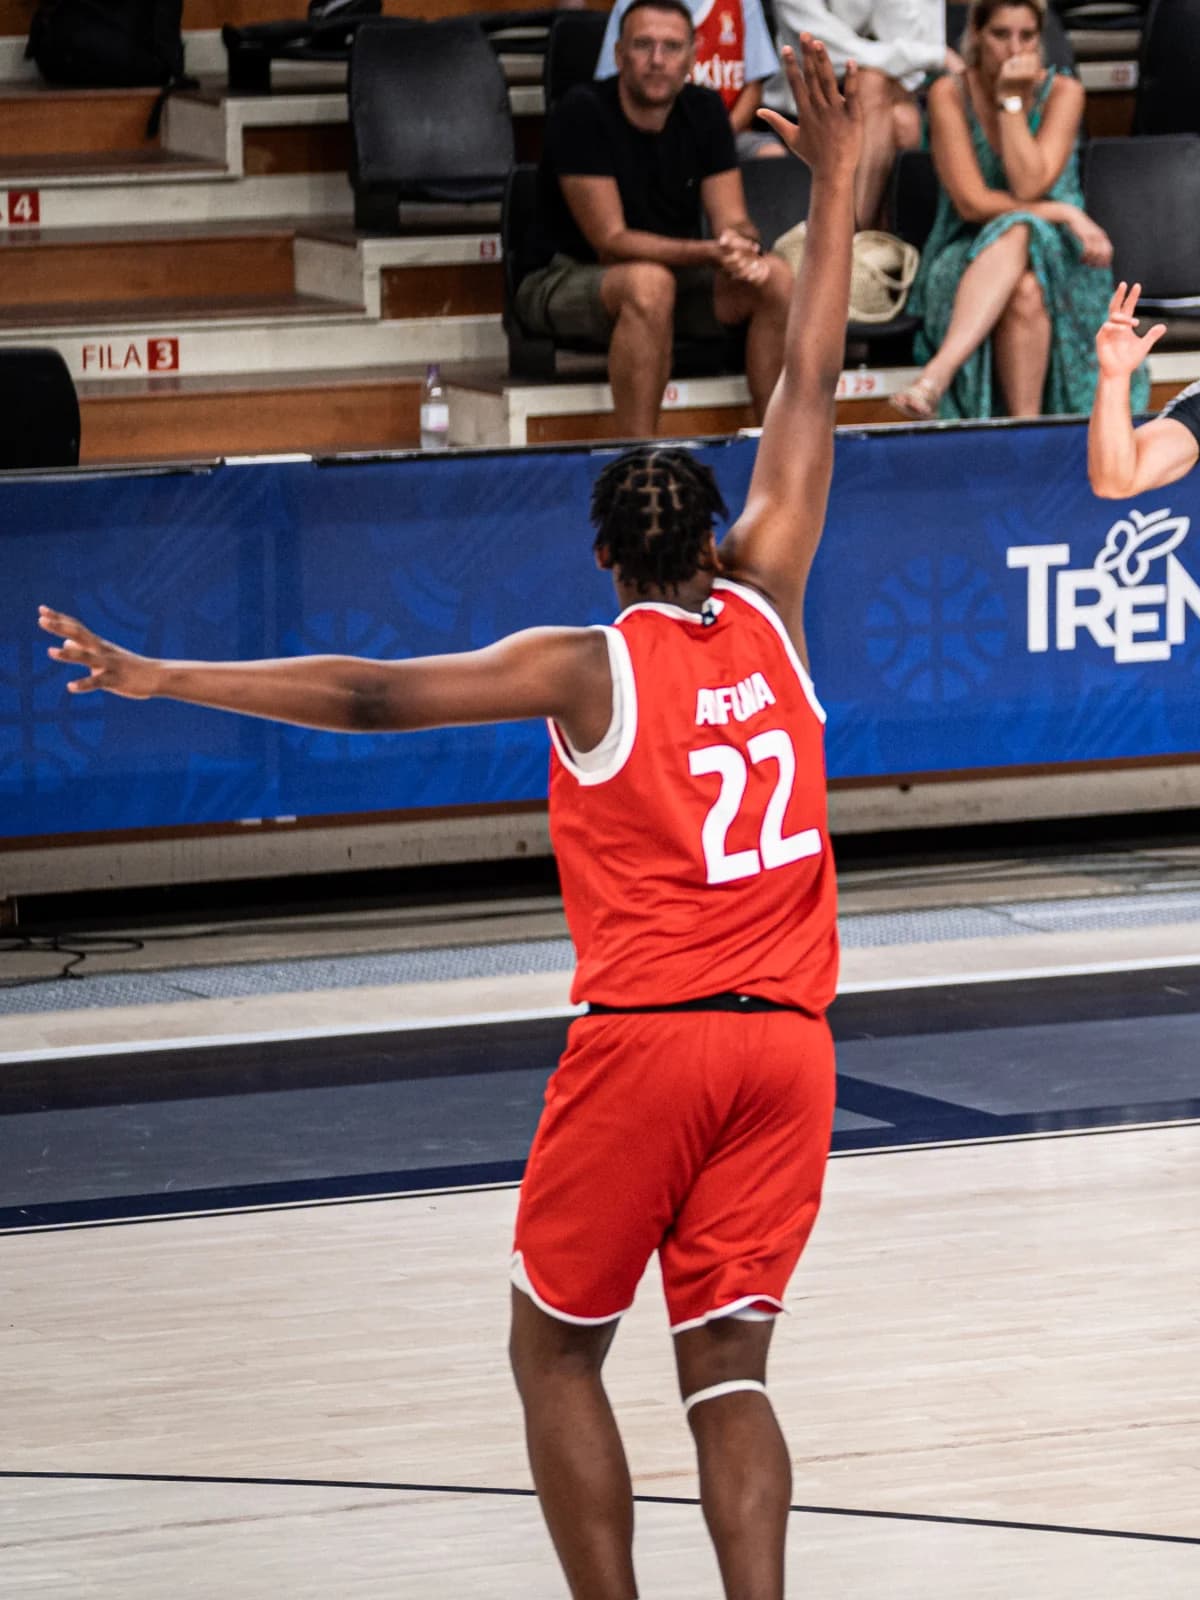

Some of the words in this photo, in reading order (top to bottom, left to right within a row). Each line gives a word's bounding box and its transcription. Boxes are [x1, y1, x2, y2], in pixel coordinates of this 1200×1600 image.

[13, 193, 33, 222] 4
[82, 343, 142, 371] FILA
[154, 340, 174, 369] 3
[688, 729, 822, 885] 22
